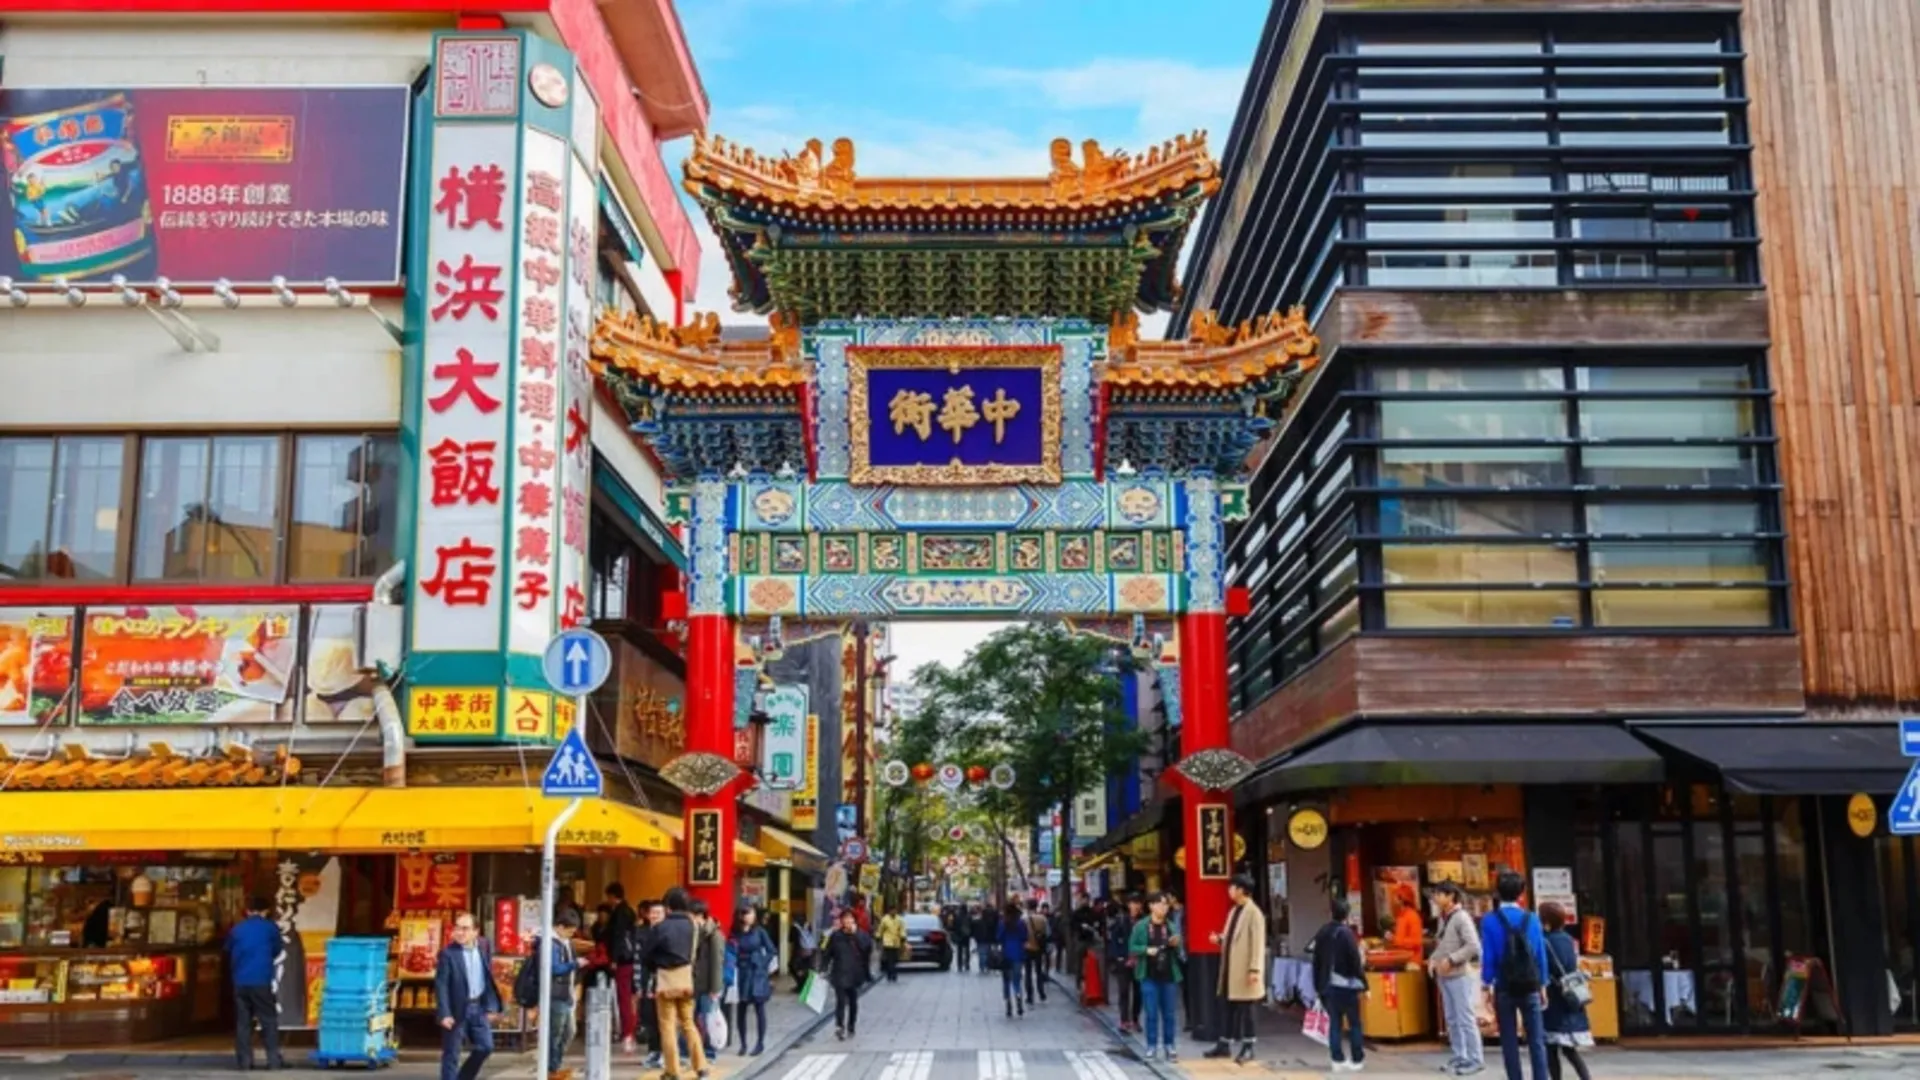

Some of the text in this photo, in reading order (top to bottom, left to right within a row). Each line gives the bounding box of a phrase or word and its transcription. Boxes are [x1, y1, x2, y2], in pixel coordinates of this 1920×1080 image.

[160, 210, 389, 229] 伝統を守り続けてきた本場の味
[420, 164, 506, 607] 横浜大飯店
[417, 692, 493, 714] 中華街
[417, 716, 492, 730] 大通り入口
[515, 695, 543, 732] 入口
[556, 829, 619, 844] 浜大飯店
